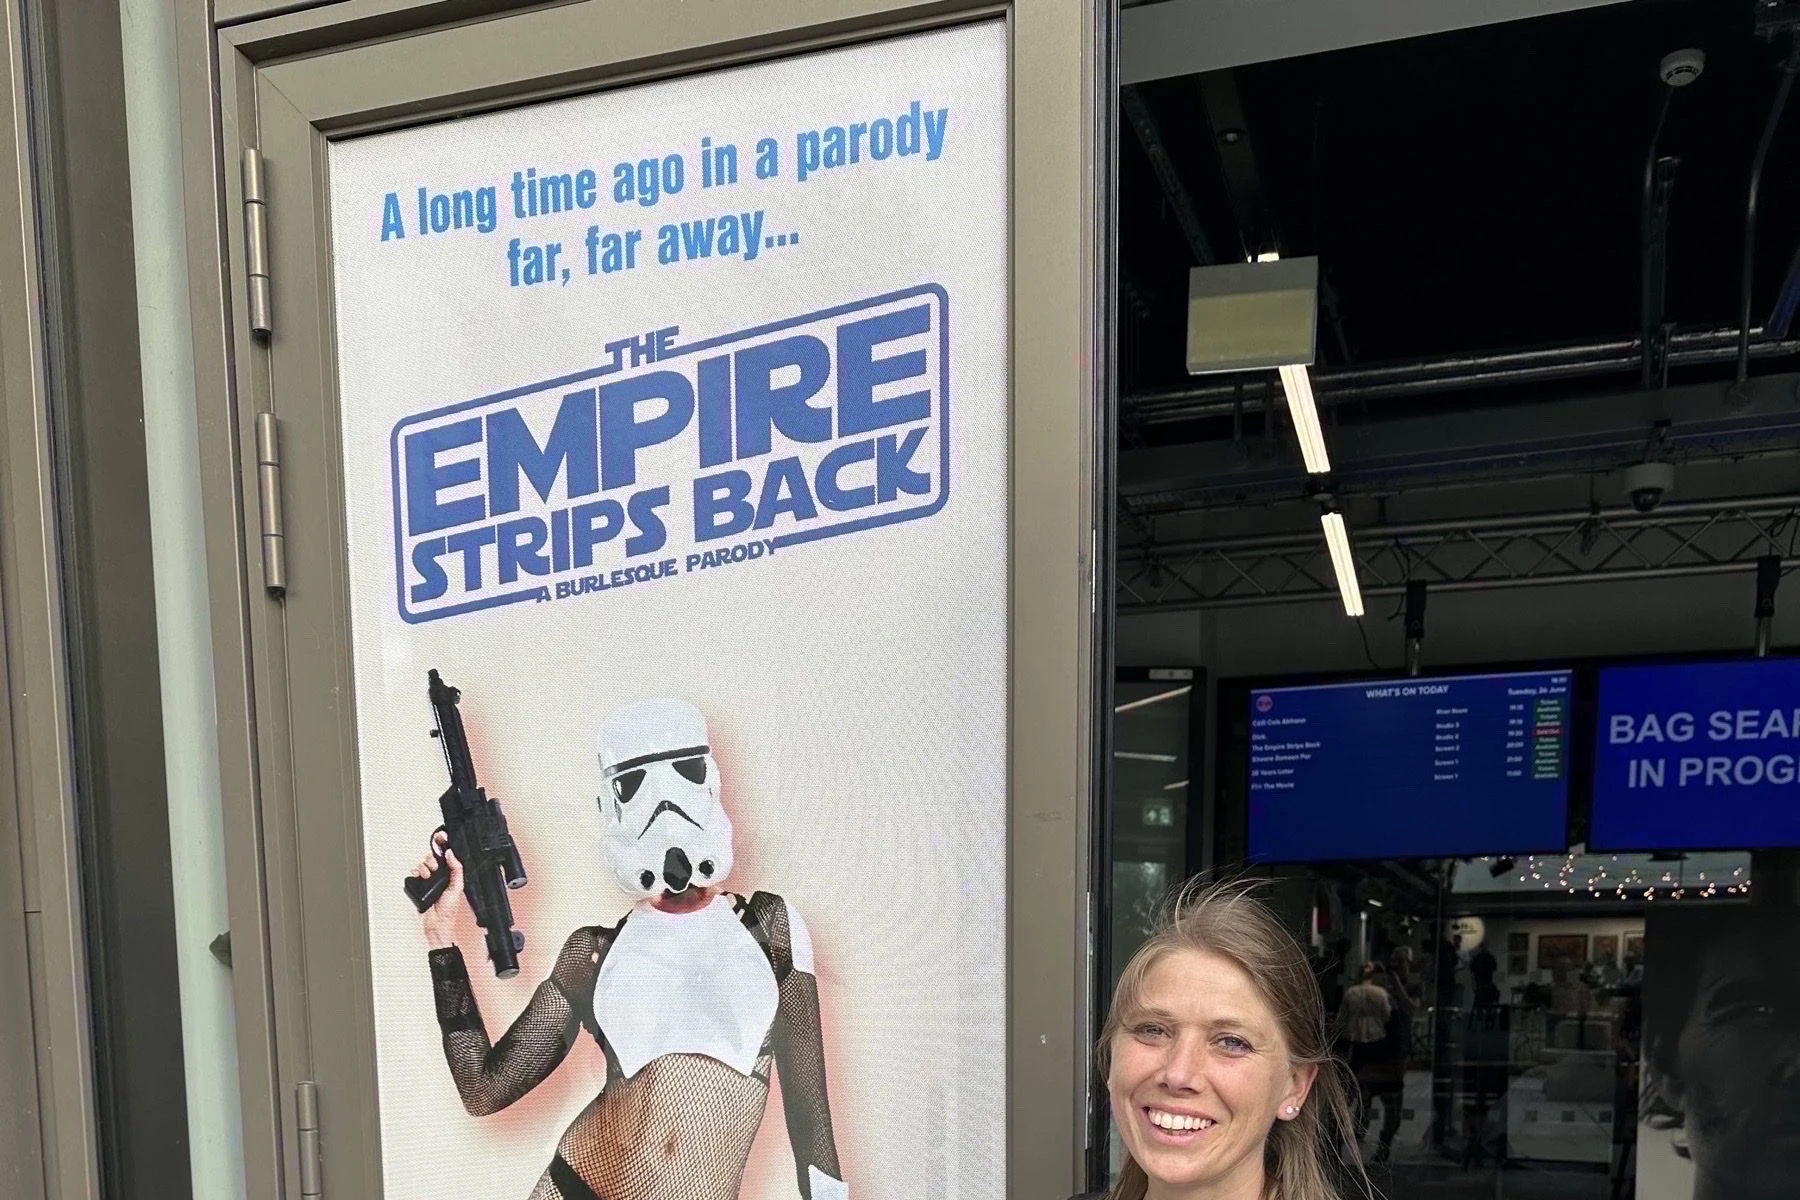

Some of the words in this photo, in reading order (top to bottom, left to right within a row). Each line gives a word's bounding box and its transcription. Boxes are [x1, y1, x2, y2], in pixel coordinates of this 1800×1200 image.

[380, 192, 405, 242] A
[418, 181, 497, 235] long
[511, 167, 597, 219] time
[613, 153, 685, 208] ago
[701, 137, 738, 189] in
[755, 137, 779, 180] a
[797, 101, 949, 183] parody
[507, 235, 570, 287] far,
[585, 224, 642, 277] far
[657, 208, 800, 266] away...
[604, 326, 680, 368] THE
[404, 303, 932, 537] EMPIRE
[411, 485, 670, 604] STRIPS
[693, 426, 932, 543] BACK
[536, 585, 552, 603] A
[555, 557, 679, 601] BURLESQUE
[686, 538, 779, 574] PARODY
[1366, 686, 1400, 698] WHAT'S
[1402, 686, 1416, 697] ON
[1417, 684, 1449, 696] TODAY
[1549, 686, 1567, 694] June
[1609, 712, 1695, 744] BAG
[1628, 758, 1665, 788] IN
[1679, 755, 1800, 787] PROG
